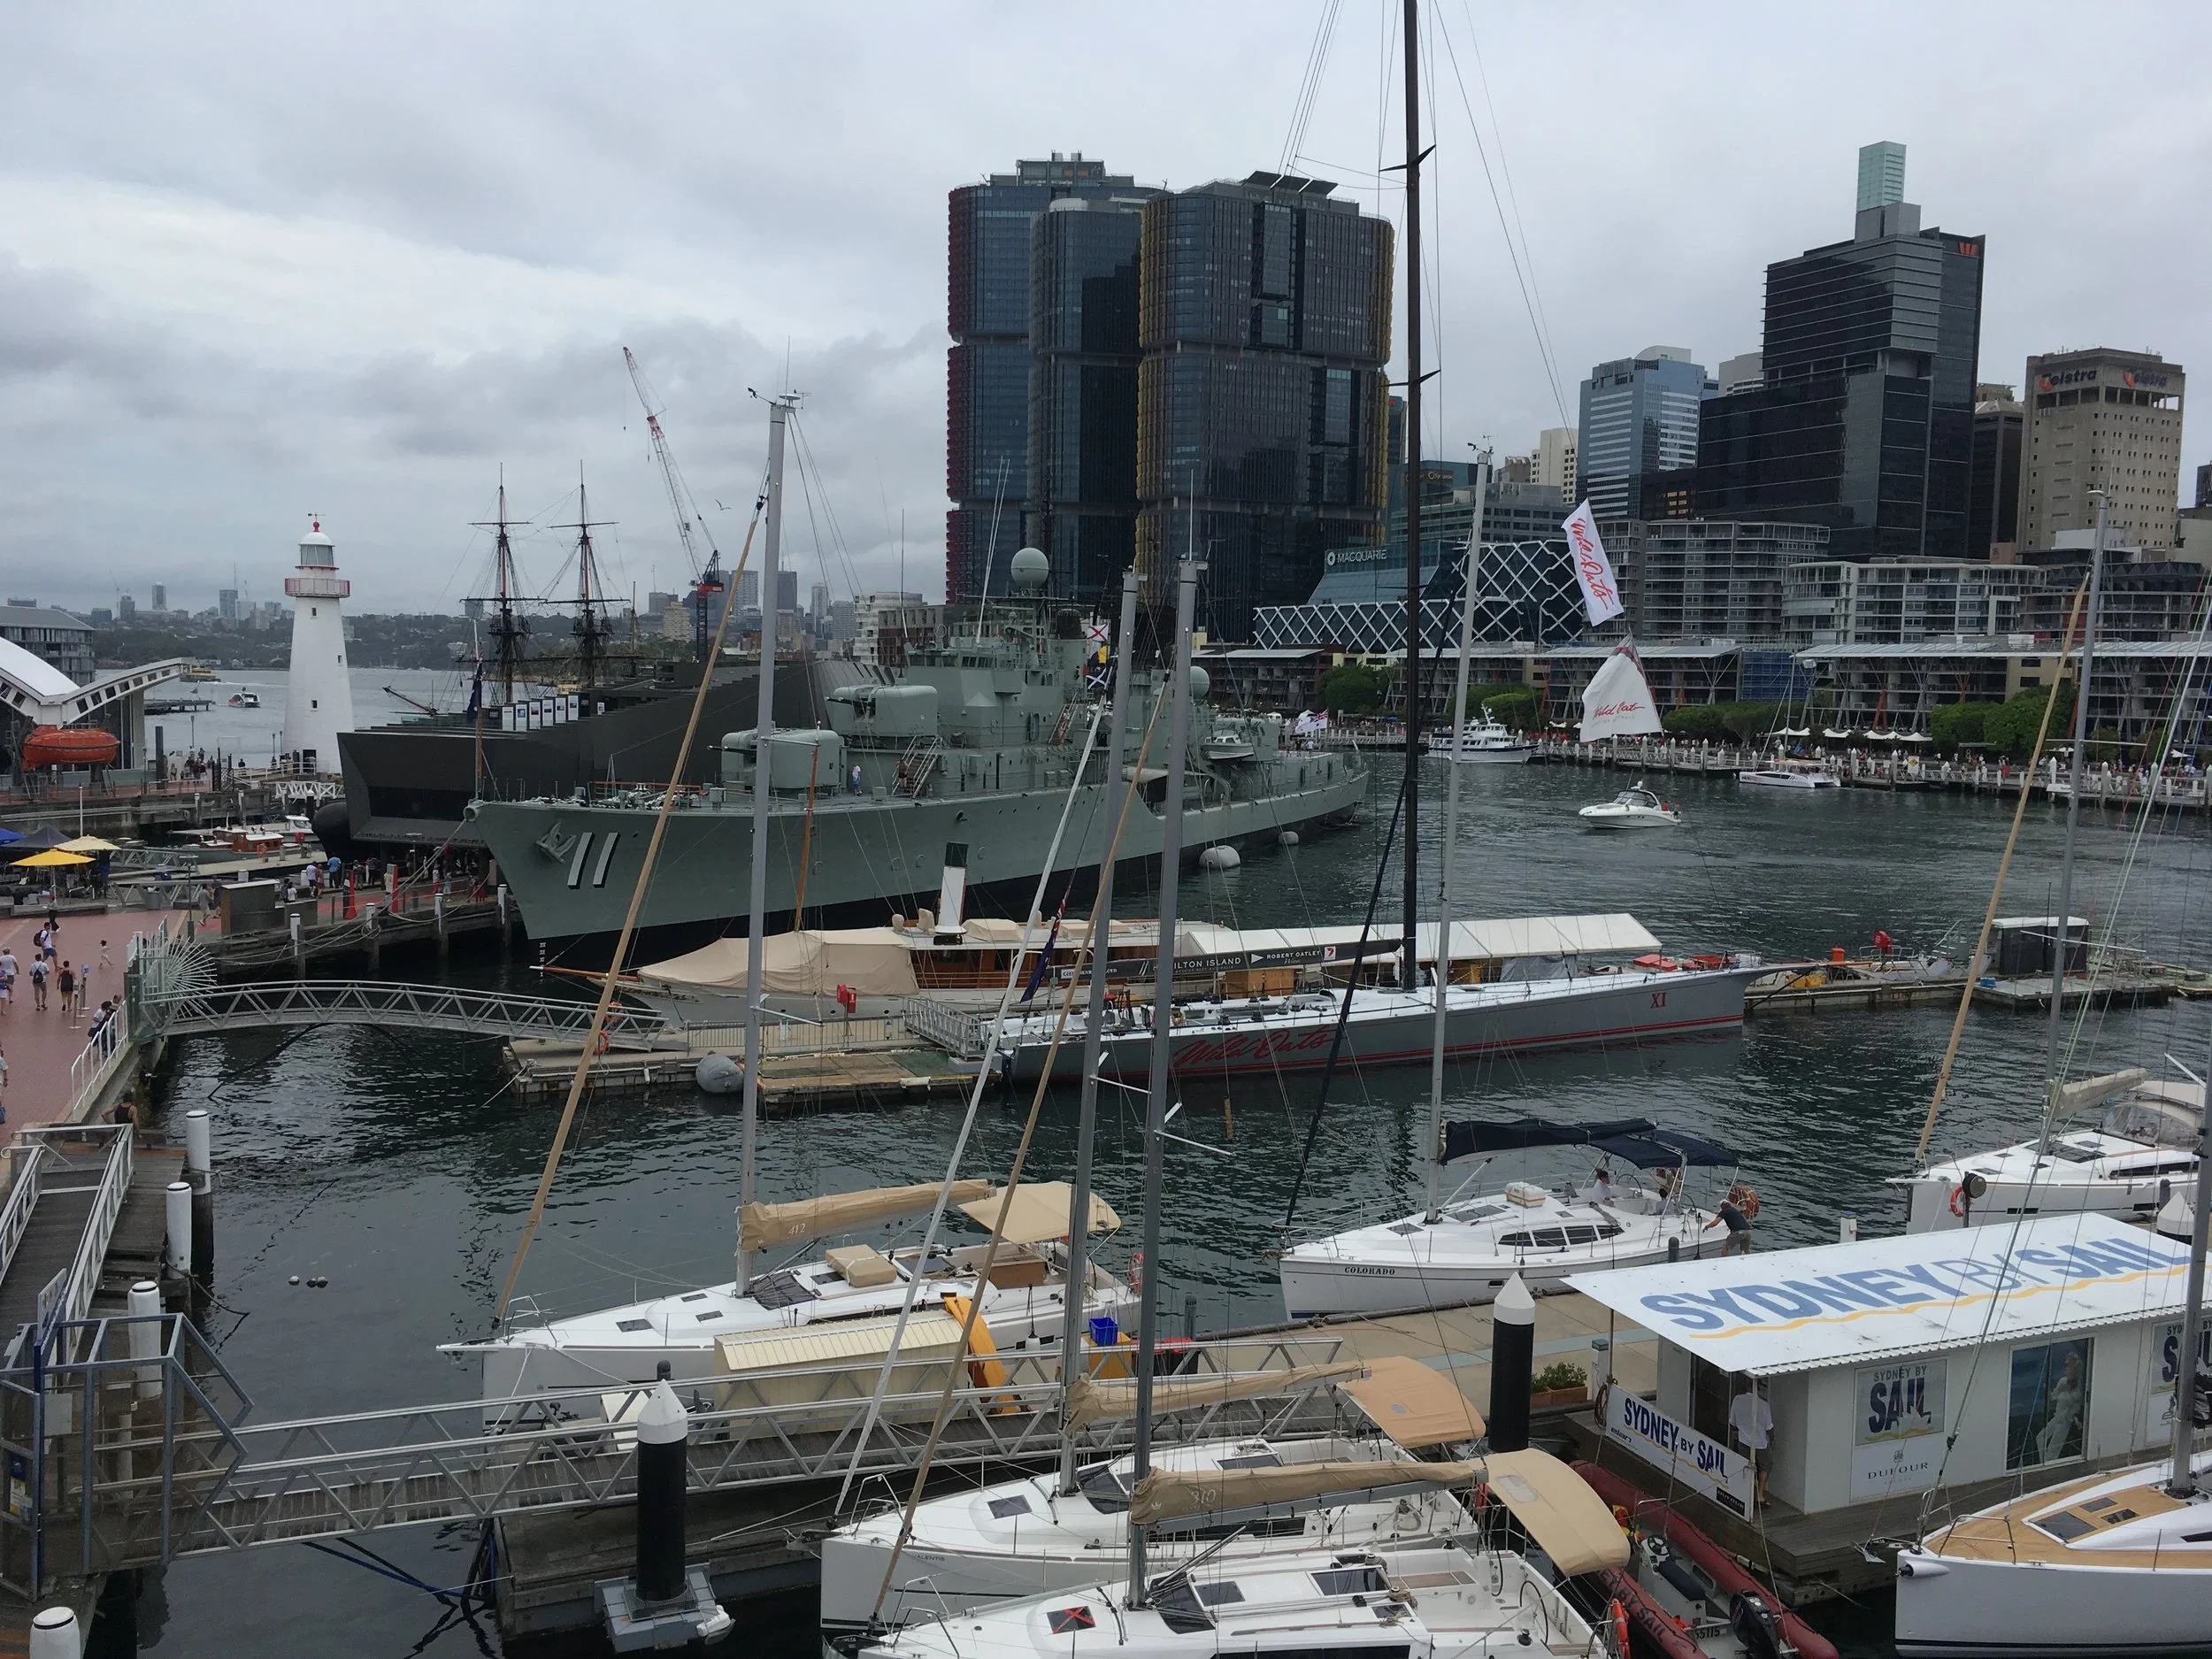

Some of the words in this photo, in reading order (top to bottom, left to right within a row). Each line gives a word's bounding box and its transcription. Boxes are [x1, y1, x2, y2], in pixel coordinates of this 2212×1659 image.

[2038, 369, 2098, 392] Telstra
[1337, 549, 1387, 564] MACQUARIE
[567, 832, 622, 890] 11
[1153, 960, 1202, 972] HILTON
[1206, 957, 1241, 967] ISLAND
[1650, 991, 1668, 1009] XI
[787, 1223, 806, 1235] 412
[1344, 1266, 1395, 1276] COLORADO
[1640, 1264, 1969, 1330] SYDNEY
[1931, 1254, 2049, 1293] BY
[2018, 1238, 2192, 1279] SAIL
[1873, 1365, 1912, 1382] SYDNEY
[1915, 1364, 1927, 1376] BY
[1868, 1377, 1932, 1433] SAIL
[1624, 1397, 1679, 1453] SYDNEY
[1681, 1437, 1694, 1455] BY
[1697, 1440, 1728, 1484] SAIL
[1868, 1462, 1929, 1479] DUFOUR
[1190, 1488, 1216, 1503] 310
